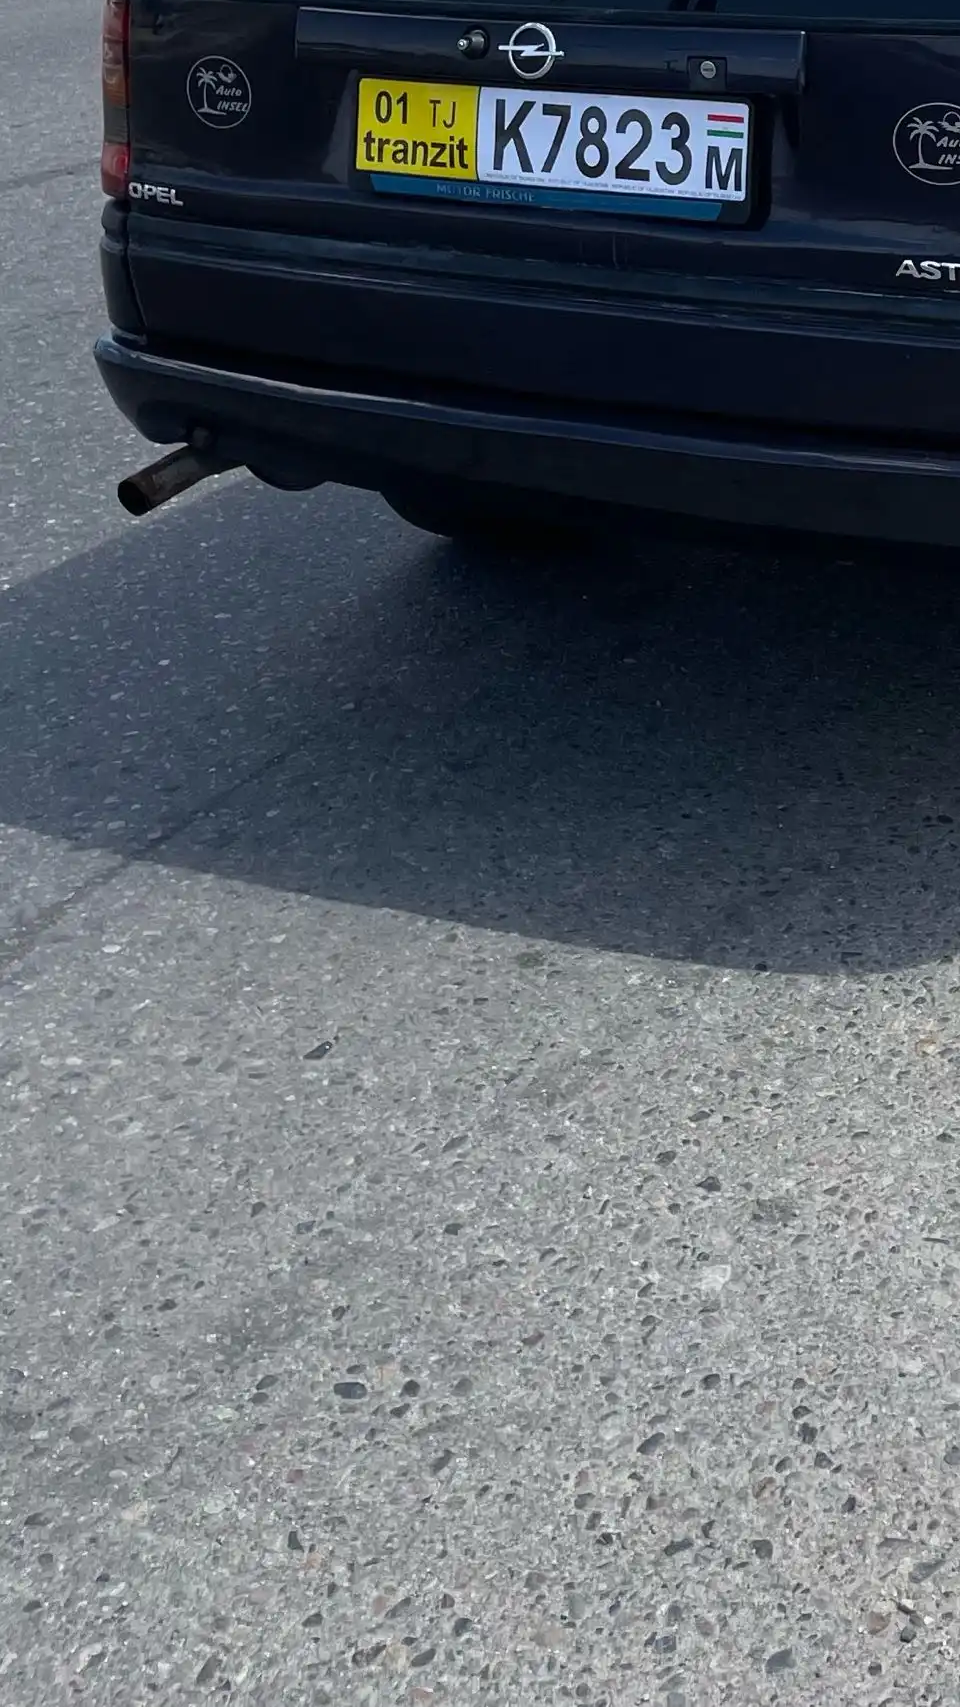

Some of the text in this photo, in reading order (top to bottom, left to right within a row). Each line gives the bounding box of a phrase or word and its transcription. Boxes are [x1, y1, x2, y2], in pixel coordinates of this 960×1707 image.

[215, 85, 243, 97] Auto
[216, 100, 248, 112] INSEL
[375, 90, 457, 129] 01 TJ
[363, 130, 469, 170] tranzit
[493, 98, 743, 192] K7823 M
[128, 181, 184, 207] OPEL
